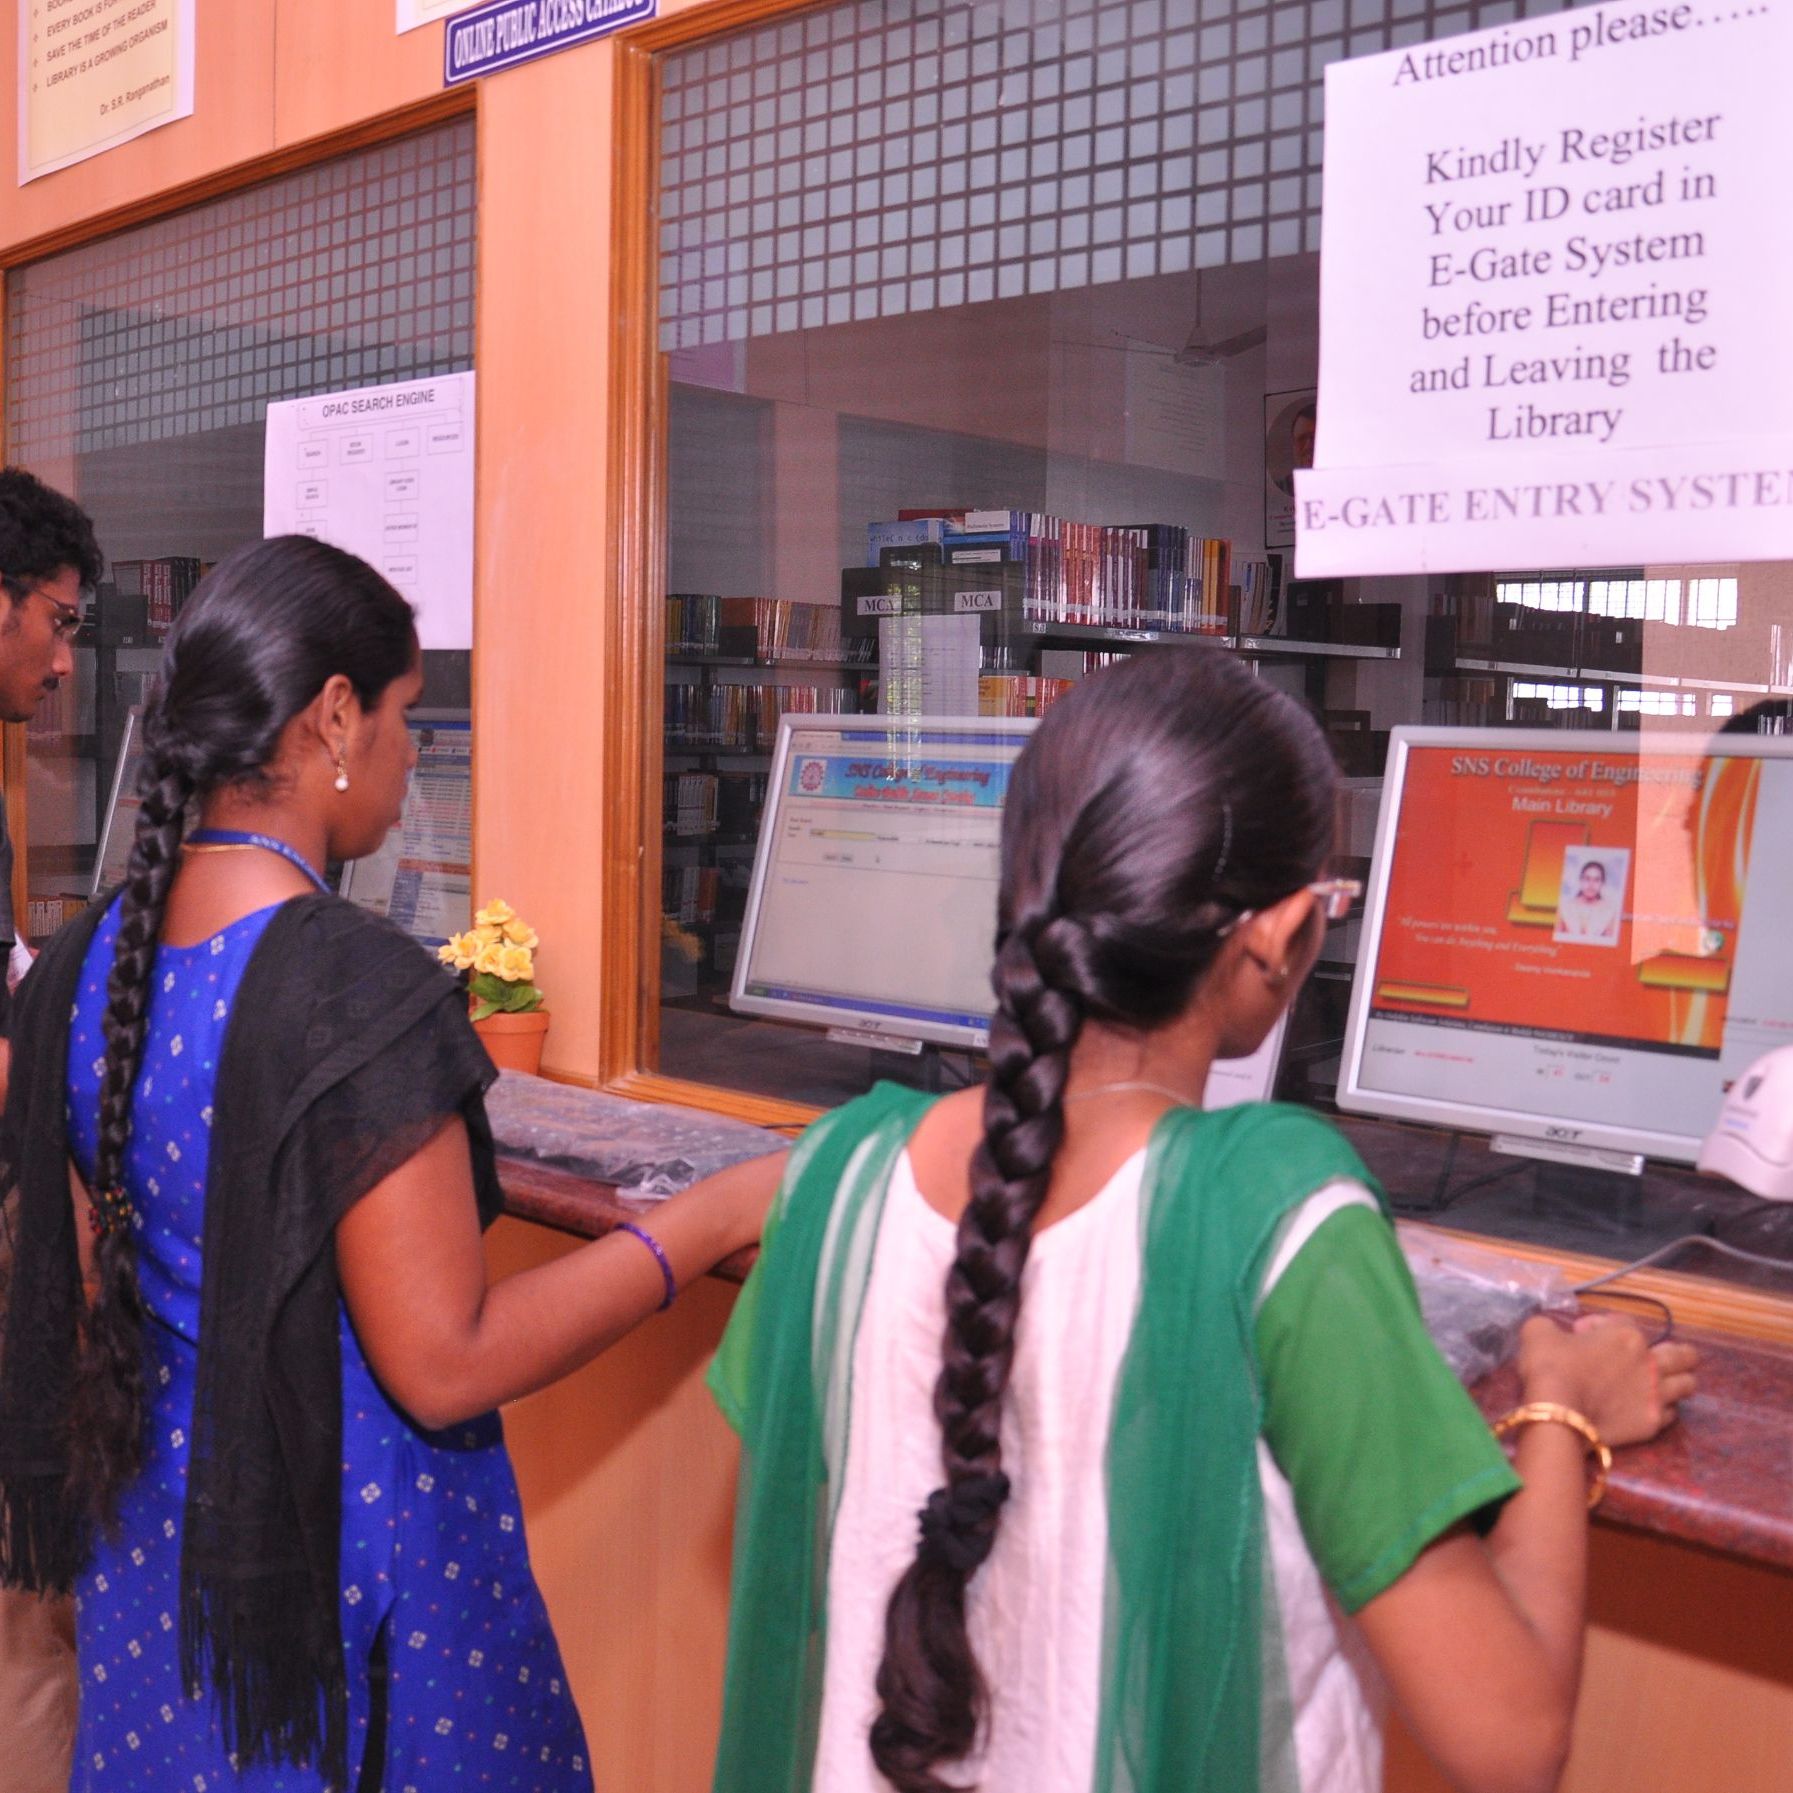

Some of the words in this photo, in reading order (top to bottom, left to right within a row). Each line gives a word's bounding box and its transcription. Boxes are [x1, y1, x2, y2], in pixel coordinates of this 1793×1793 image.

[47, 18, 71, 37] EVERY
[72, 8, 94, 25] BOOK
[47, 45, 66, 61] SAVE
[68, 38, 82, 52] THE
[84, 28, 100, 45] TIME
[101, 22, 111, 37] OF
[112, 14, 126, 29] THE
[127, 0, 157, 21] READER
[454, 17, 495, 68] ONLINE
[496, 2, 537, 54] PUBLIC
[538, 0, 584, 39] ACCESS
[46, 67, 79, 87] LIBRARY
[80, 61, 86, 73] IS
[87, 58, 94, 68] A
[95, 40, 128, 66] GROWING
[129, 19, 168, 48] ORGANISM
[1392, 31, 1557, 86] Attention
[1424, 137, 1546, 184] Kindly
[1560, 113, 1722, 165] Register
[1424, 197, 1512, 236] Your
[1524, 186, 1570, 223] ID
[1583, 170, 1664, 214] card
[1681, 165, 1716, 202] in
[1429, 246, 1551, 288] E-Gate
[1565, 231, 1704, 277] System
[1422, 303, 1531, 340] before
[1545, 283, 1708, 328] Entering
[1410, 357, 1469, 394] and
[1484, 346, 1631, 388] Leaving
[1659, 337, 1716, 374] the
[322, 402, 349, 418] OPAC
[351, 395, 394, 414] SEARCH
[396, 388, 435, 407] ENGINE
[1487, 404, 1624, 443] Library
[1303, 492, 1451, 531] E-GATE
[1464, 480, 1615, 522] ENTRY
[1628, 469, 1793, 514] SYSTE
[864, 598, 895, 612] MCA
[961, 595, 993, 608] MCA
[1451, 757, 1489, 775] SNS
[1494, 758, 1562, 782] College
[1566, 761, 1586, 778] of
[1512, 797, 1550, 811] Main
[1555, 798, 1613, 817] Library
